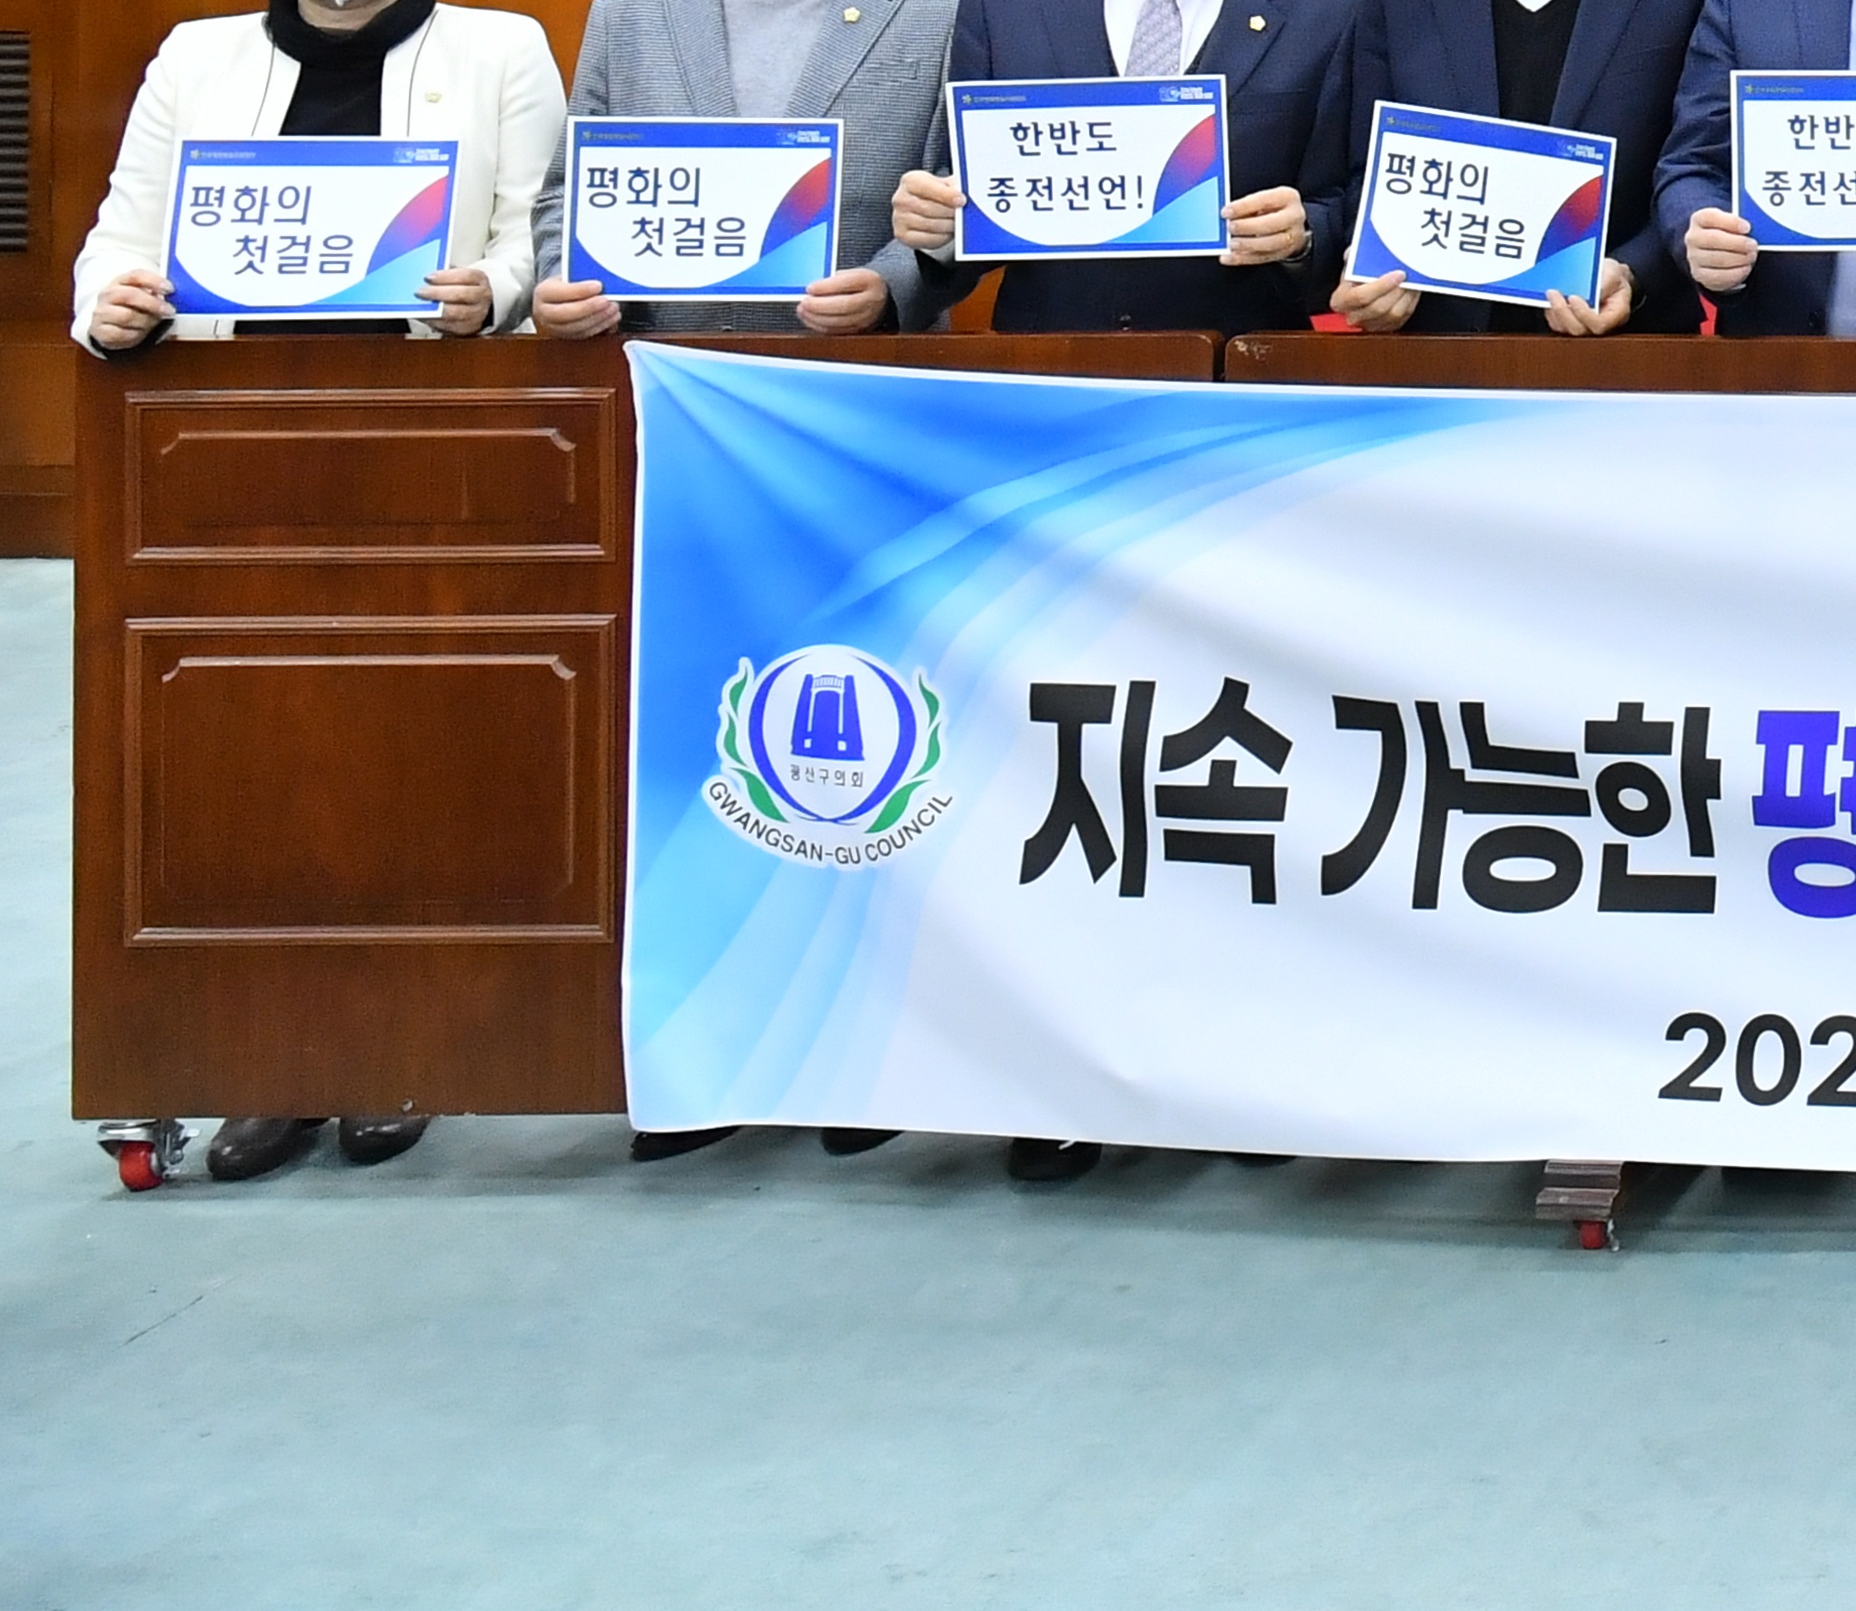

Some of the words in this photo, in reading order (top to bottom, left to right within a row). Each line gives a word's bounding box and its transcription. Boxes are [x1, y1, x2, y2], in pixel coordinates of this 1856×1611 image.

[1010, 121, 1116, 156] 한반도
[587, 167, 699, 208] 평화의
[987, 175, 1143, 214] 종전선언!
[1384, 151, 1489, 205] 평화의
[191, 186, 310, 226] 평화의
[633, 217, 745, 256] 첫걸음
[1420, 206, 1526, 260] 첫걸음
[235, 236, 352, 274] 첫걸음
[789, 764, 865, 788] 광산구의회
[1019, 677, 1292, 904] 지속
[1321, 695, 1721, 914] 가능한
[708, 781, 862, 866] GWANGSAN-GU
[864, 792, 954, 863] COUNCIL
